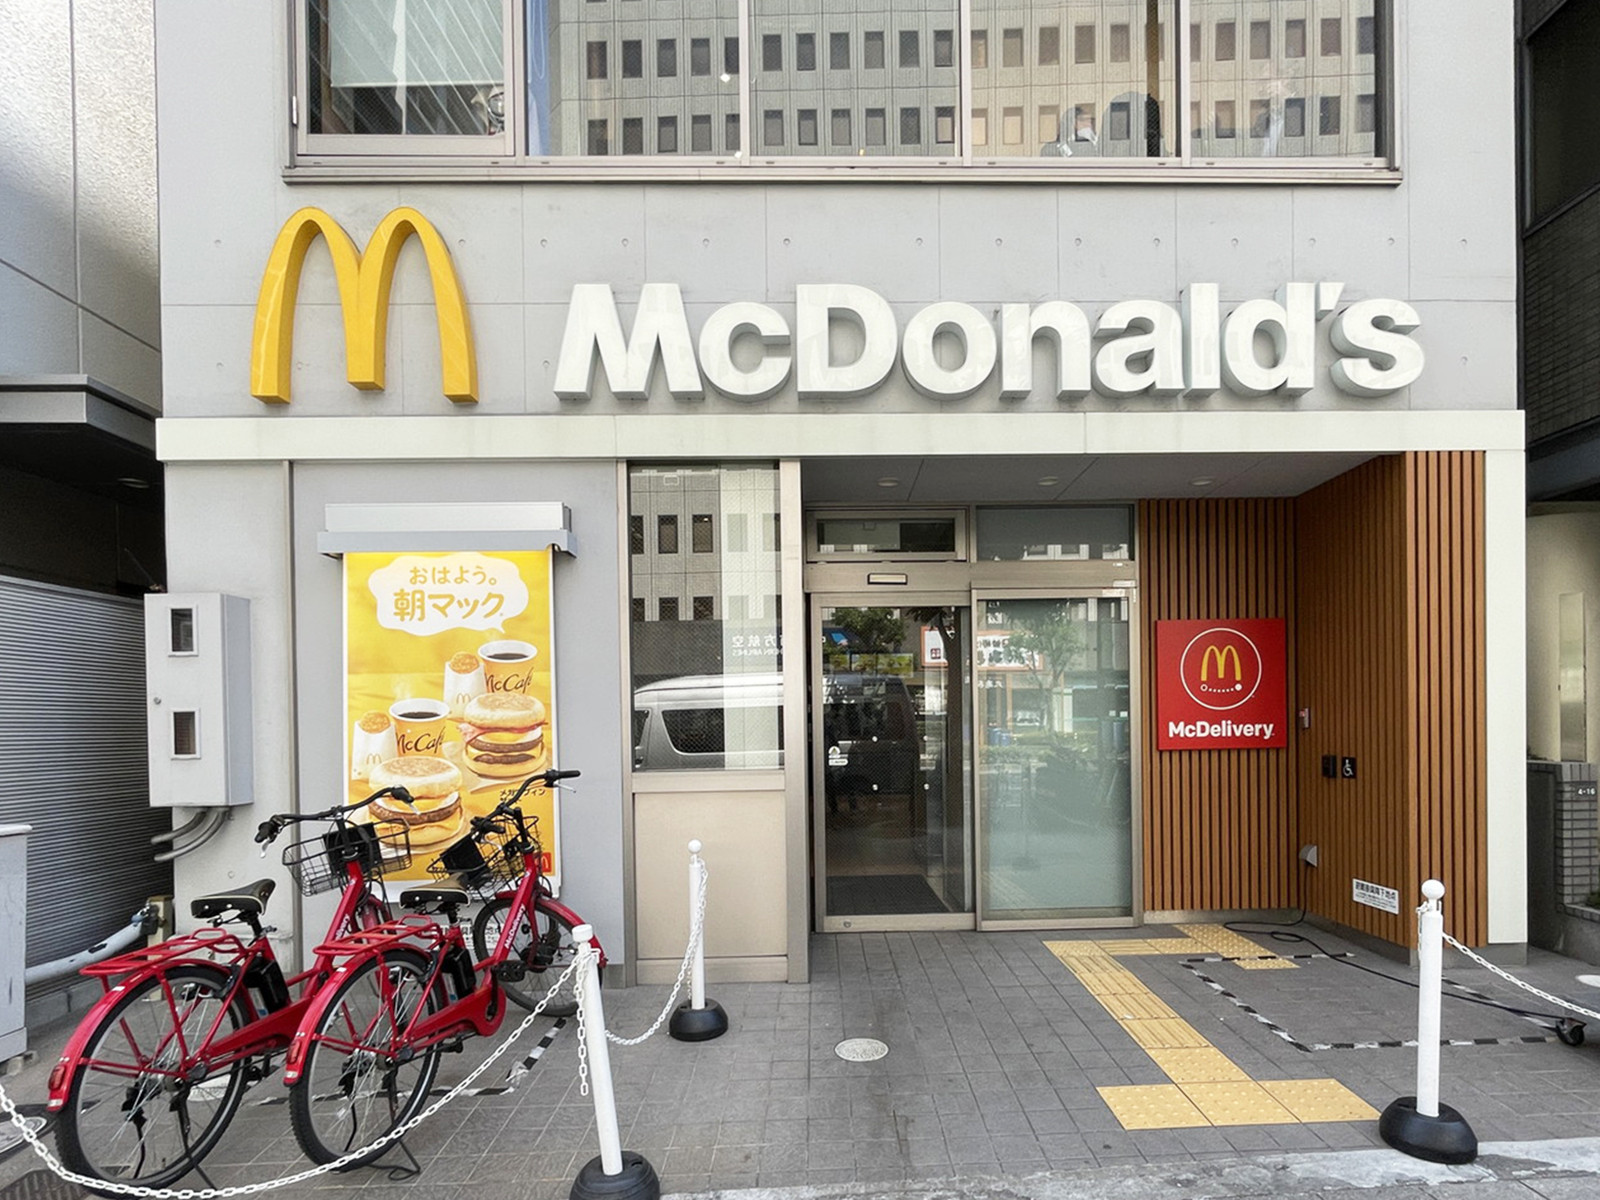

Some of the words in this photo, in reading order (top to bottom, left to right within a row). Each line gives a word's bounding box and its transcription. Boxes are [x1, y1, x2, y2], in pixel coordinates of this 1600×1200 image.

[554, 281, 1424, 398] McDonald's
[393, 588, 505, 621] 朝マック
[1168, 720, 1274, 740] McDelivery
